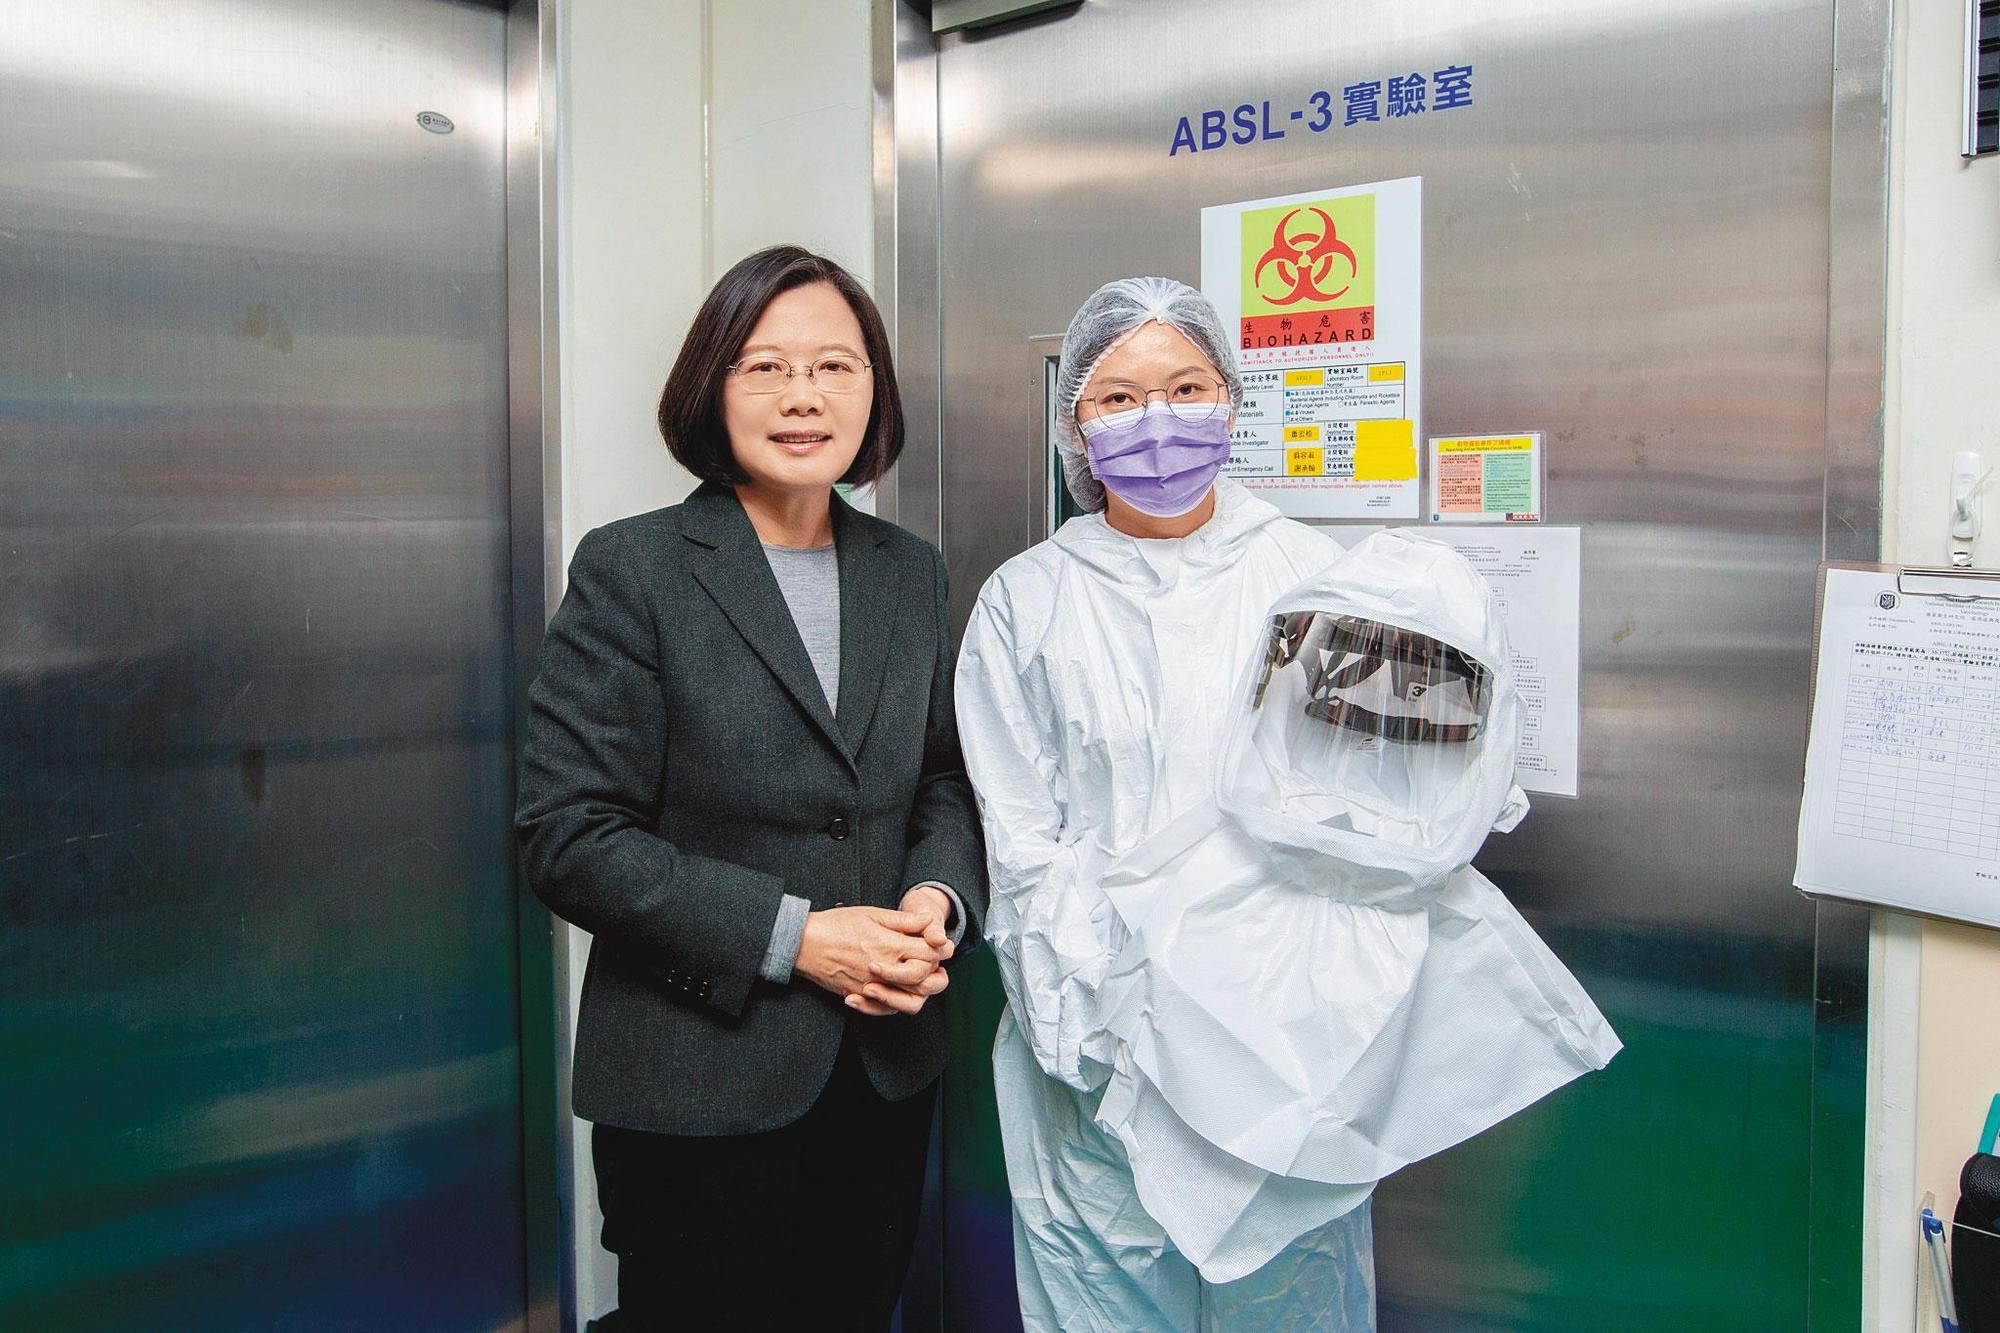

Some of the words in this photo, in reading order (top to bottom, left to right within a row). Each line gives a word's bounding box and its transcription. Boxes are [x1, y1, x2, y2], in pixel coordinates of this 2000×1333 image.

[1244, 311, 1371, 334] 生物危害
[1243, 328, 1371, 349] BIOHAZARD
